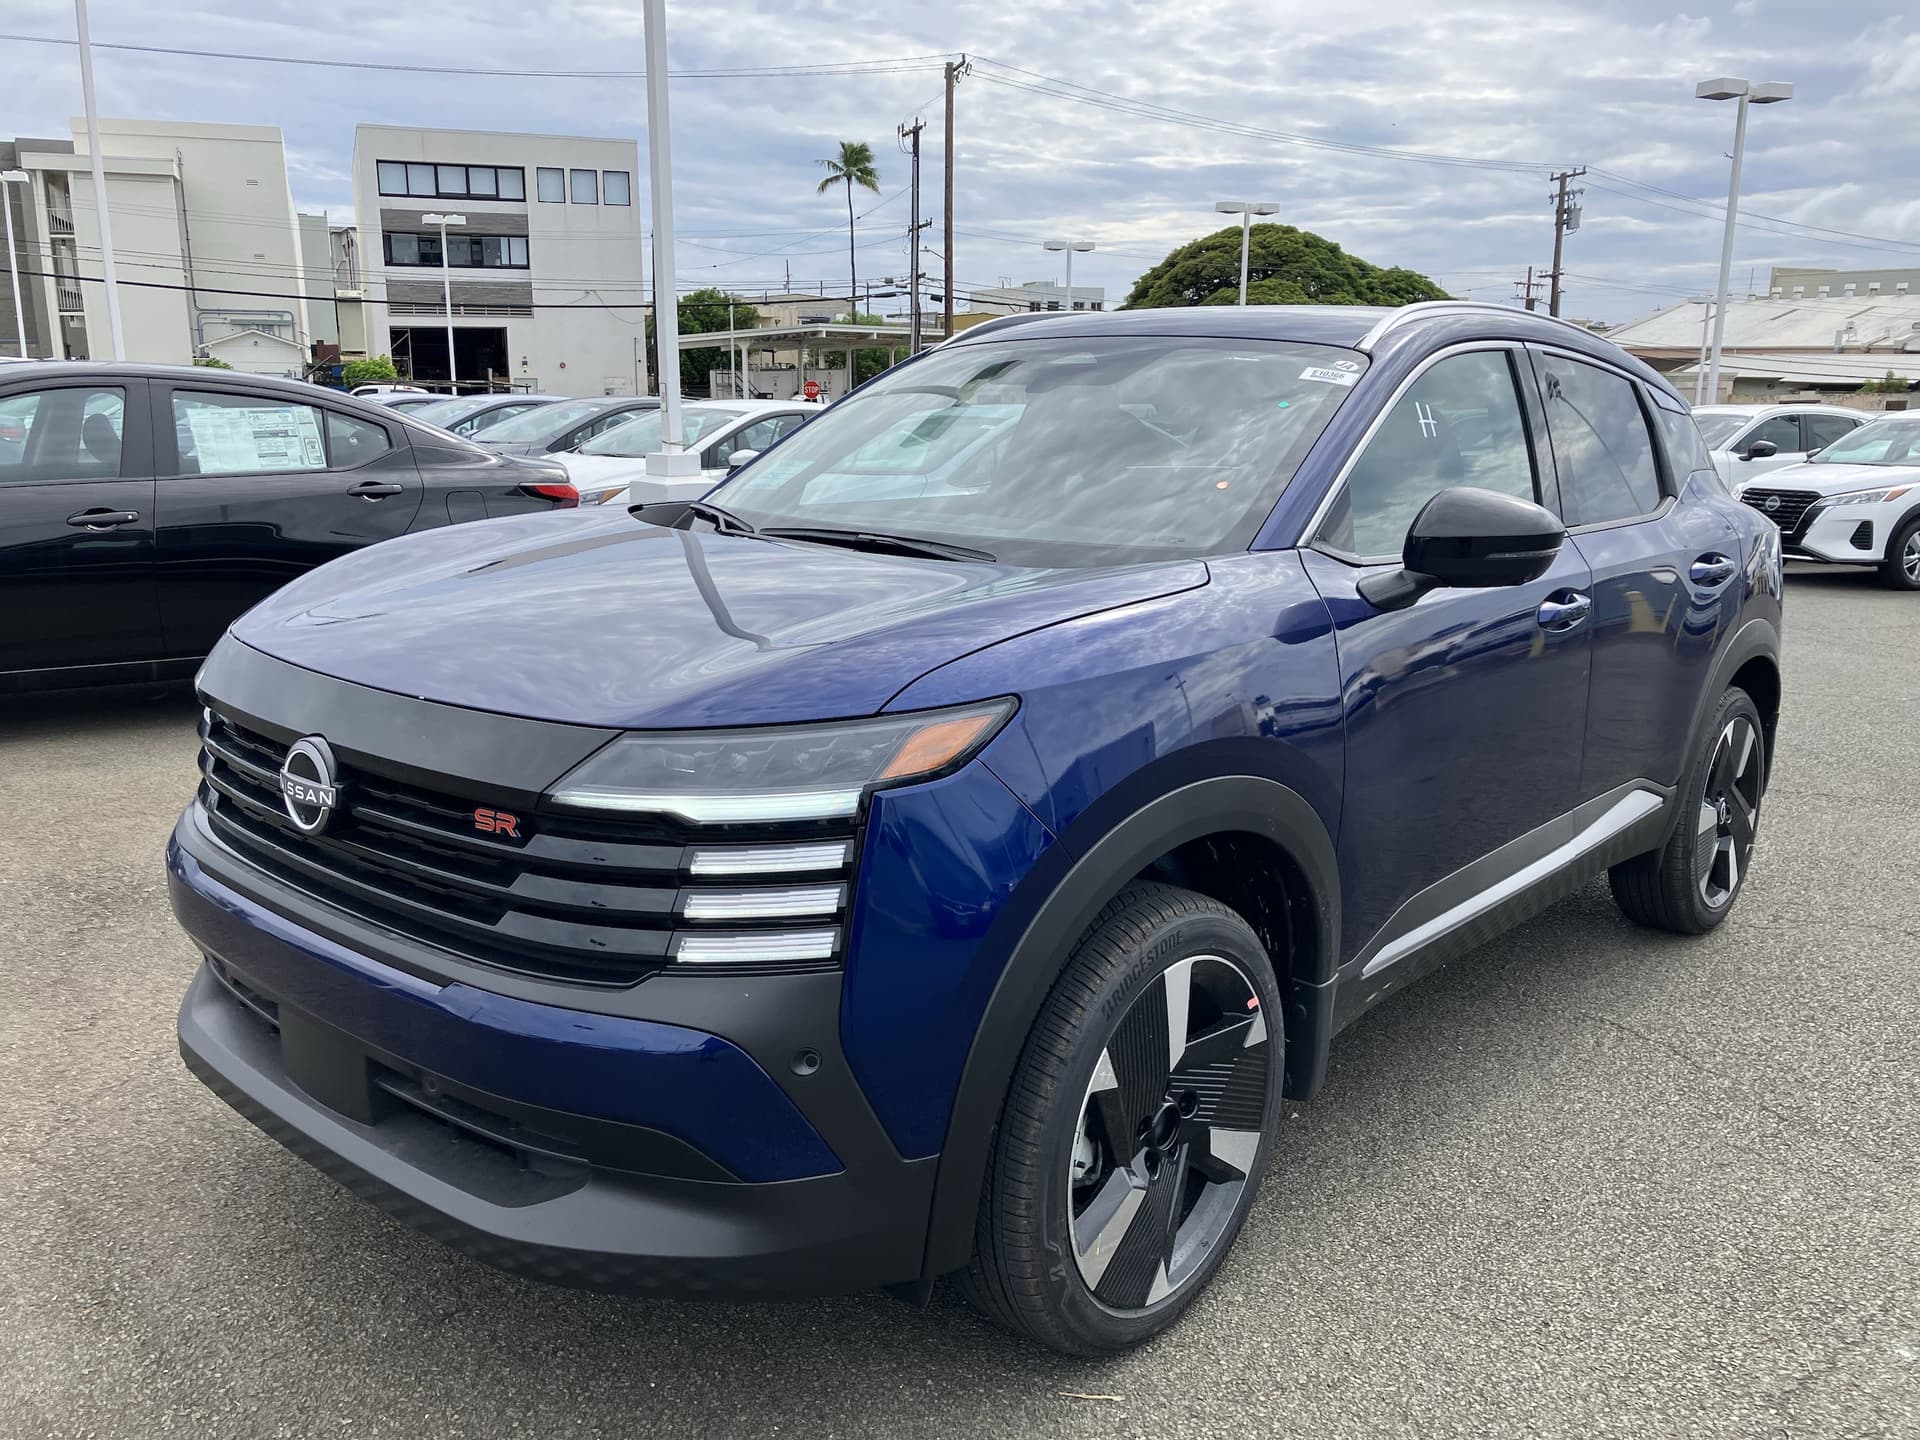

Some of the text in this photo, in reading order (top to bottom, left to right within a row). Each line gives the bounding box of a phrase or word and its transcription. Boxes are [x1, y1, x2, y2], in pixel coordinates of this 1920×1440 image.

[804, 386, 819, 394] STOP
[1415, 401, 1438, 438] H
[474, 807, 521, 838] SR
[1103, 931, 1183, 1019] BRIDGESTONE
